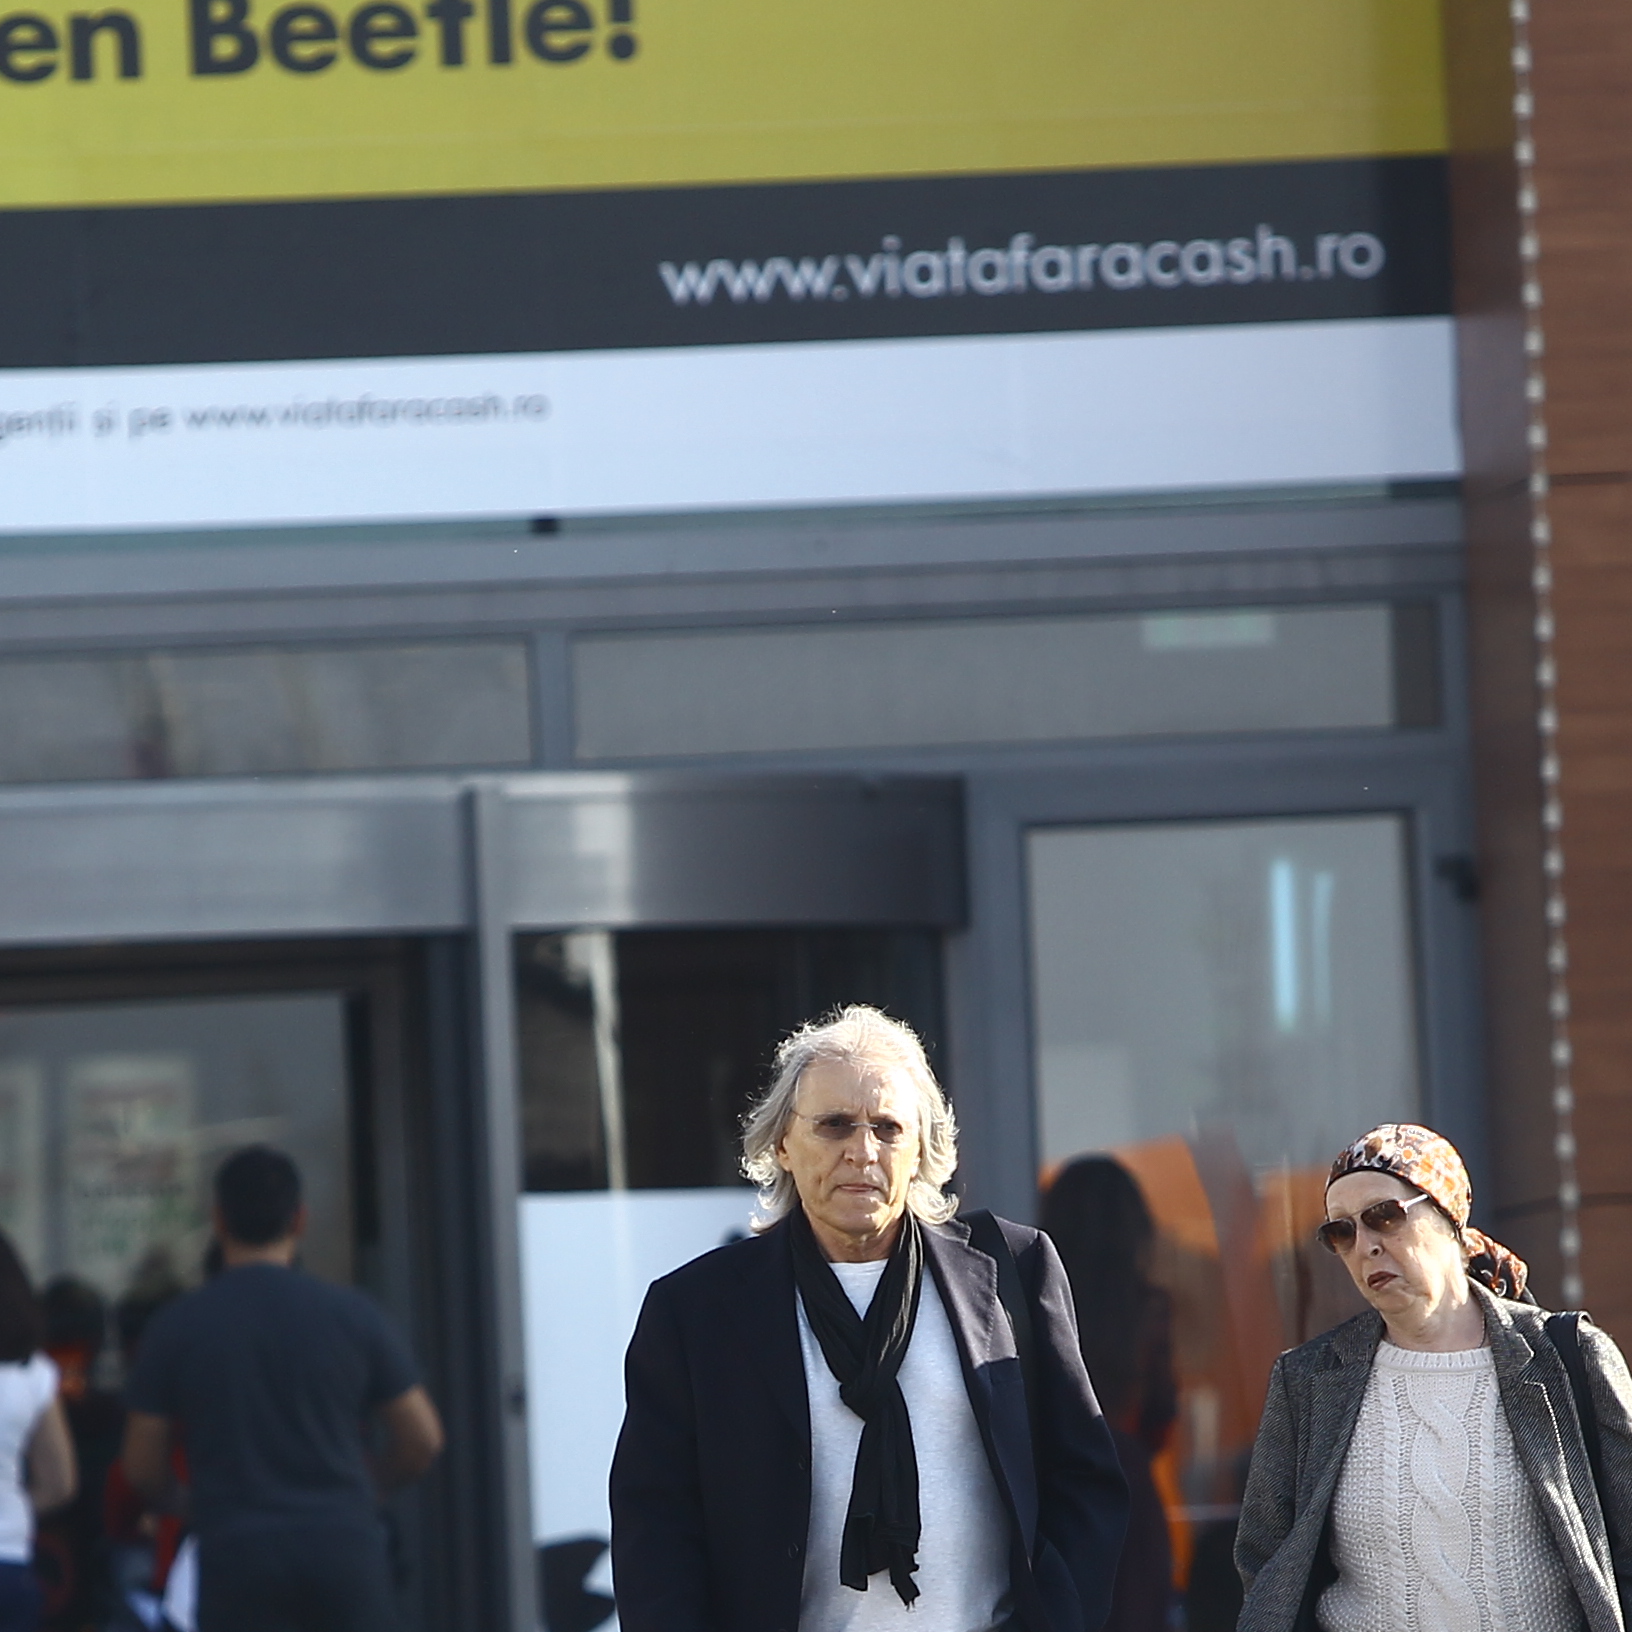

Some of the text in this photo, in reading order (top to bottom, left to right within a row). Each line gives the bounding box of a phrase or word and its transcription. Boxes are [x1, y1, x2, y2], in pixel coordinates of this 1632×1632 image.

[188, 0, 640, 79] Beetle!
[659, 224, 1386, 304] www.viatafaracash.ro
[127, 406, 174, 442] pe
[182, 391, 552, 432] www.viatafaracash.ro
